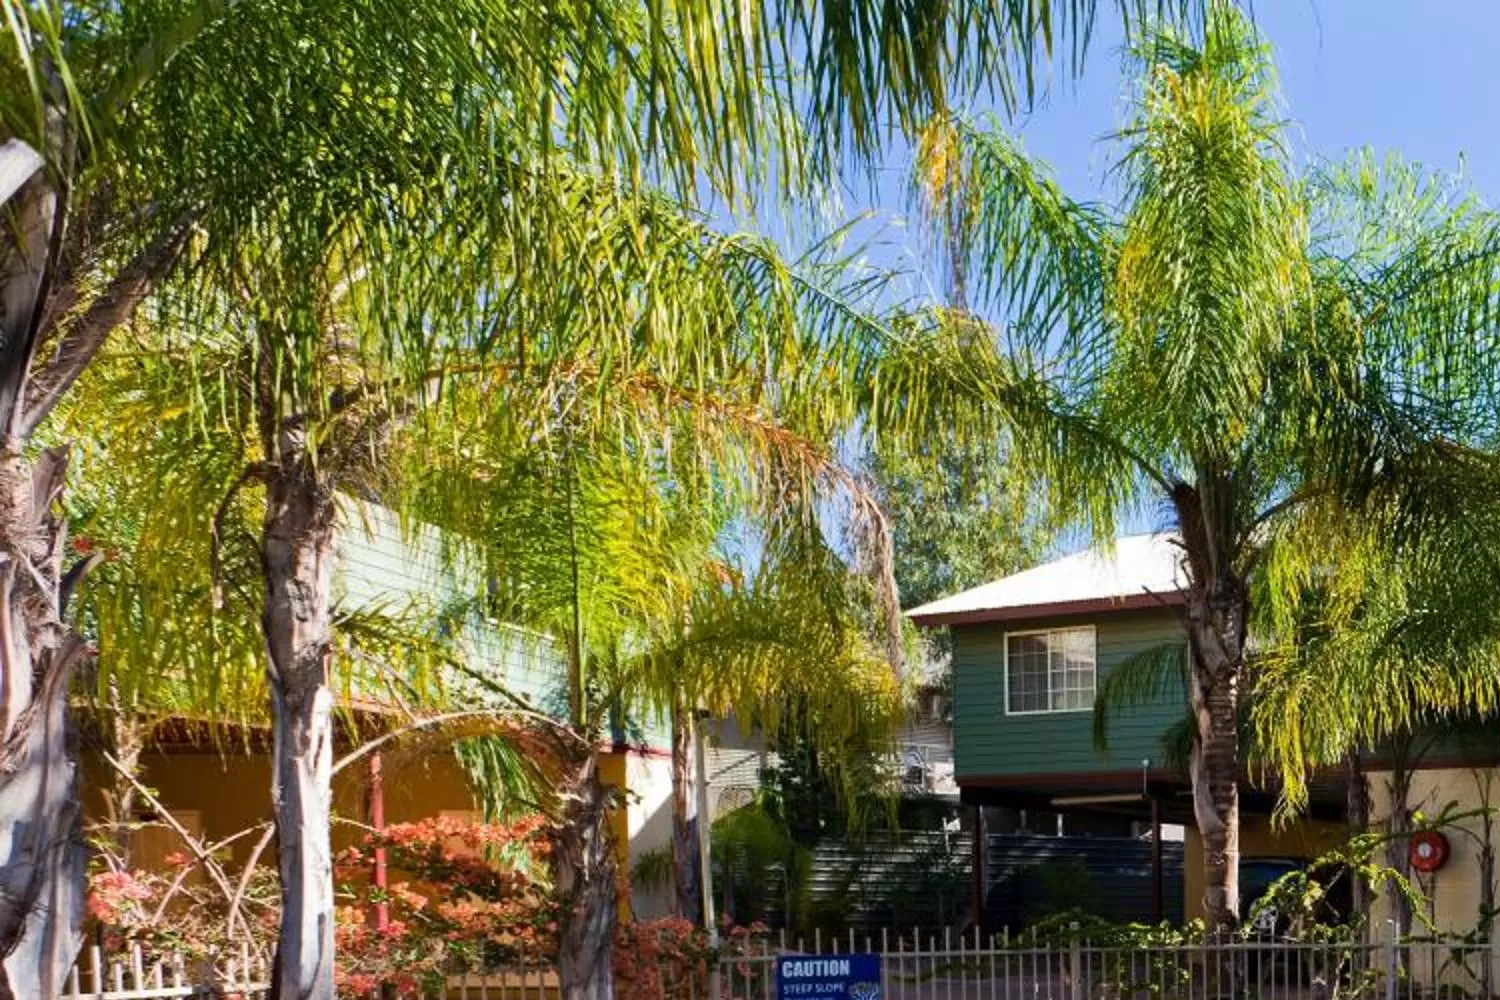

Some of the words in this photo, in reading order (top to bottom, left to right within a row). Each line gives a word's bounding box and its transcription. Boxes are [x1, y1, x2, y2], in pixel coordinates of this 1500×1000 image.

[782, 960, 849, 978] CAUTION
[783, 984, 812, 994] STEEP
[815, 982, 844, 993] SLOPE
